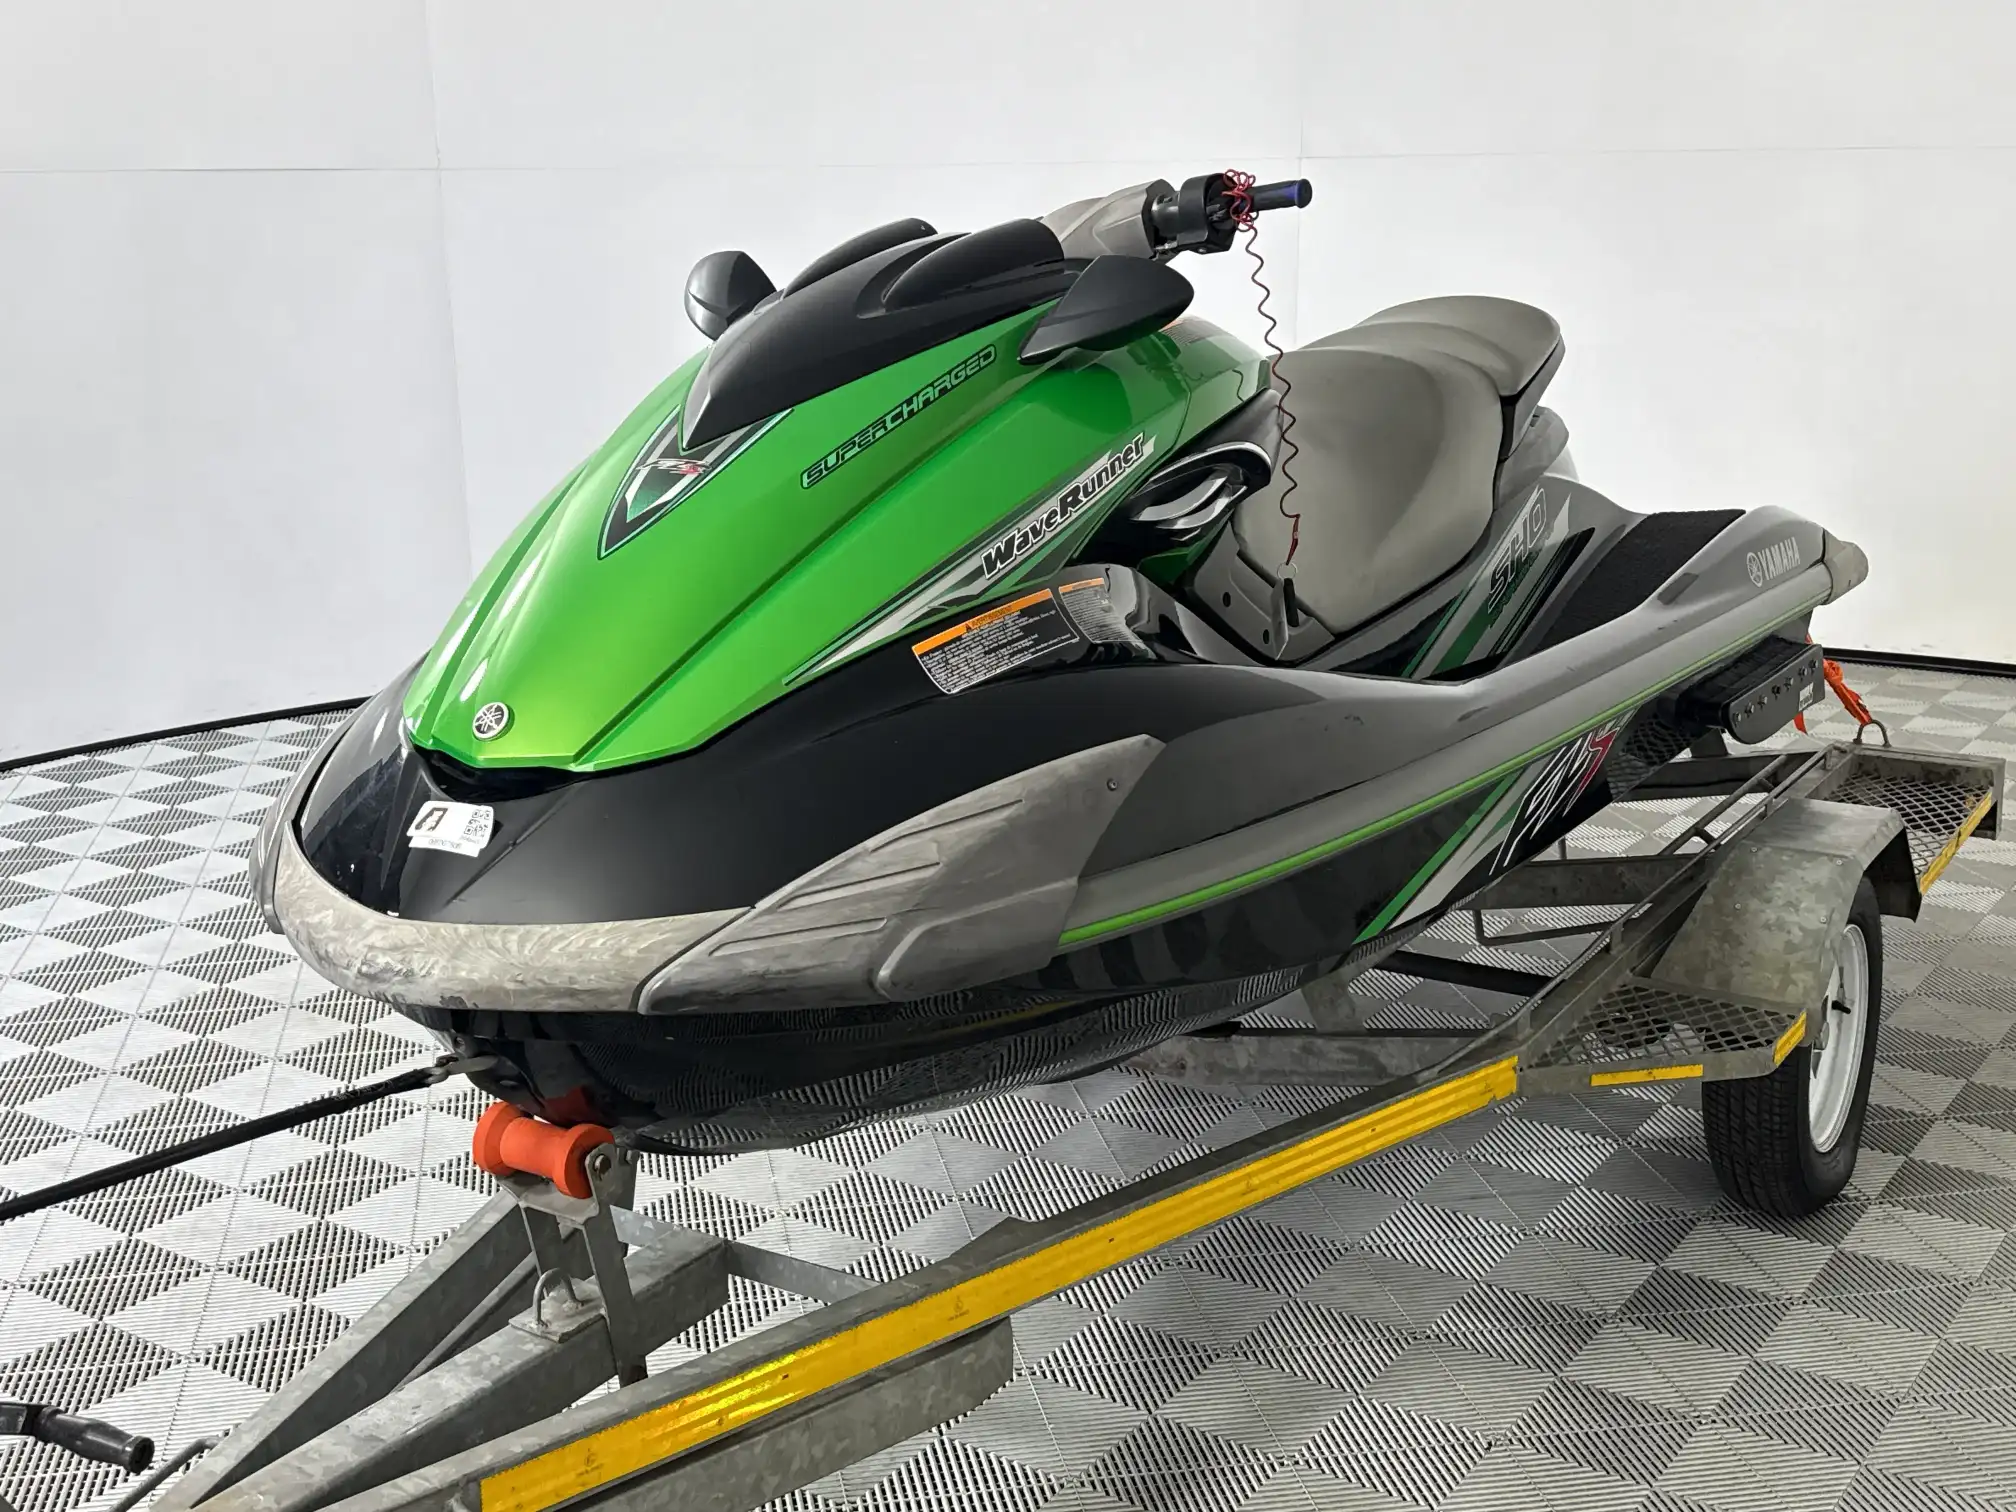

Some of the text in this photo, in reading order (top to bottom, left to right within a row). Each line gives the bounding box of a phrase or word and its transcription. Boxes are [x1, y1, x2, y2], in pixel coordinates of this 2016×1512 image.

[802, 345, 996, 488] SUPERCHARGED
[981, 432, 1145, 580] WaveRunner
[1488, 488, 1547, 614] SHO
[1757, 536, 1801, 581] YAMAHA
